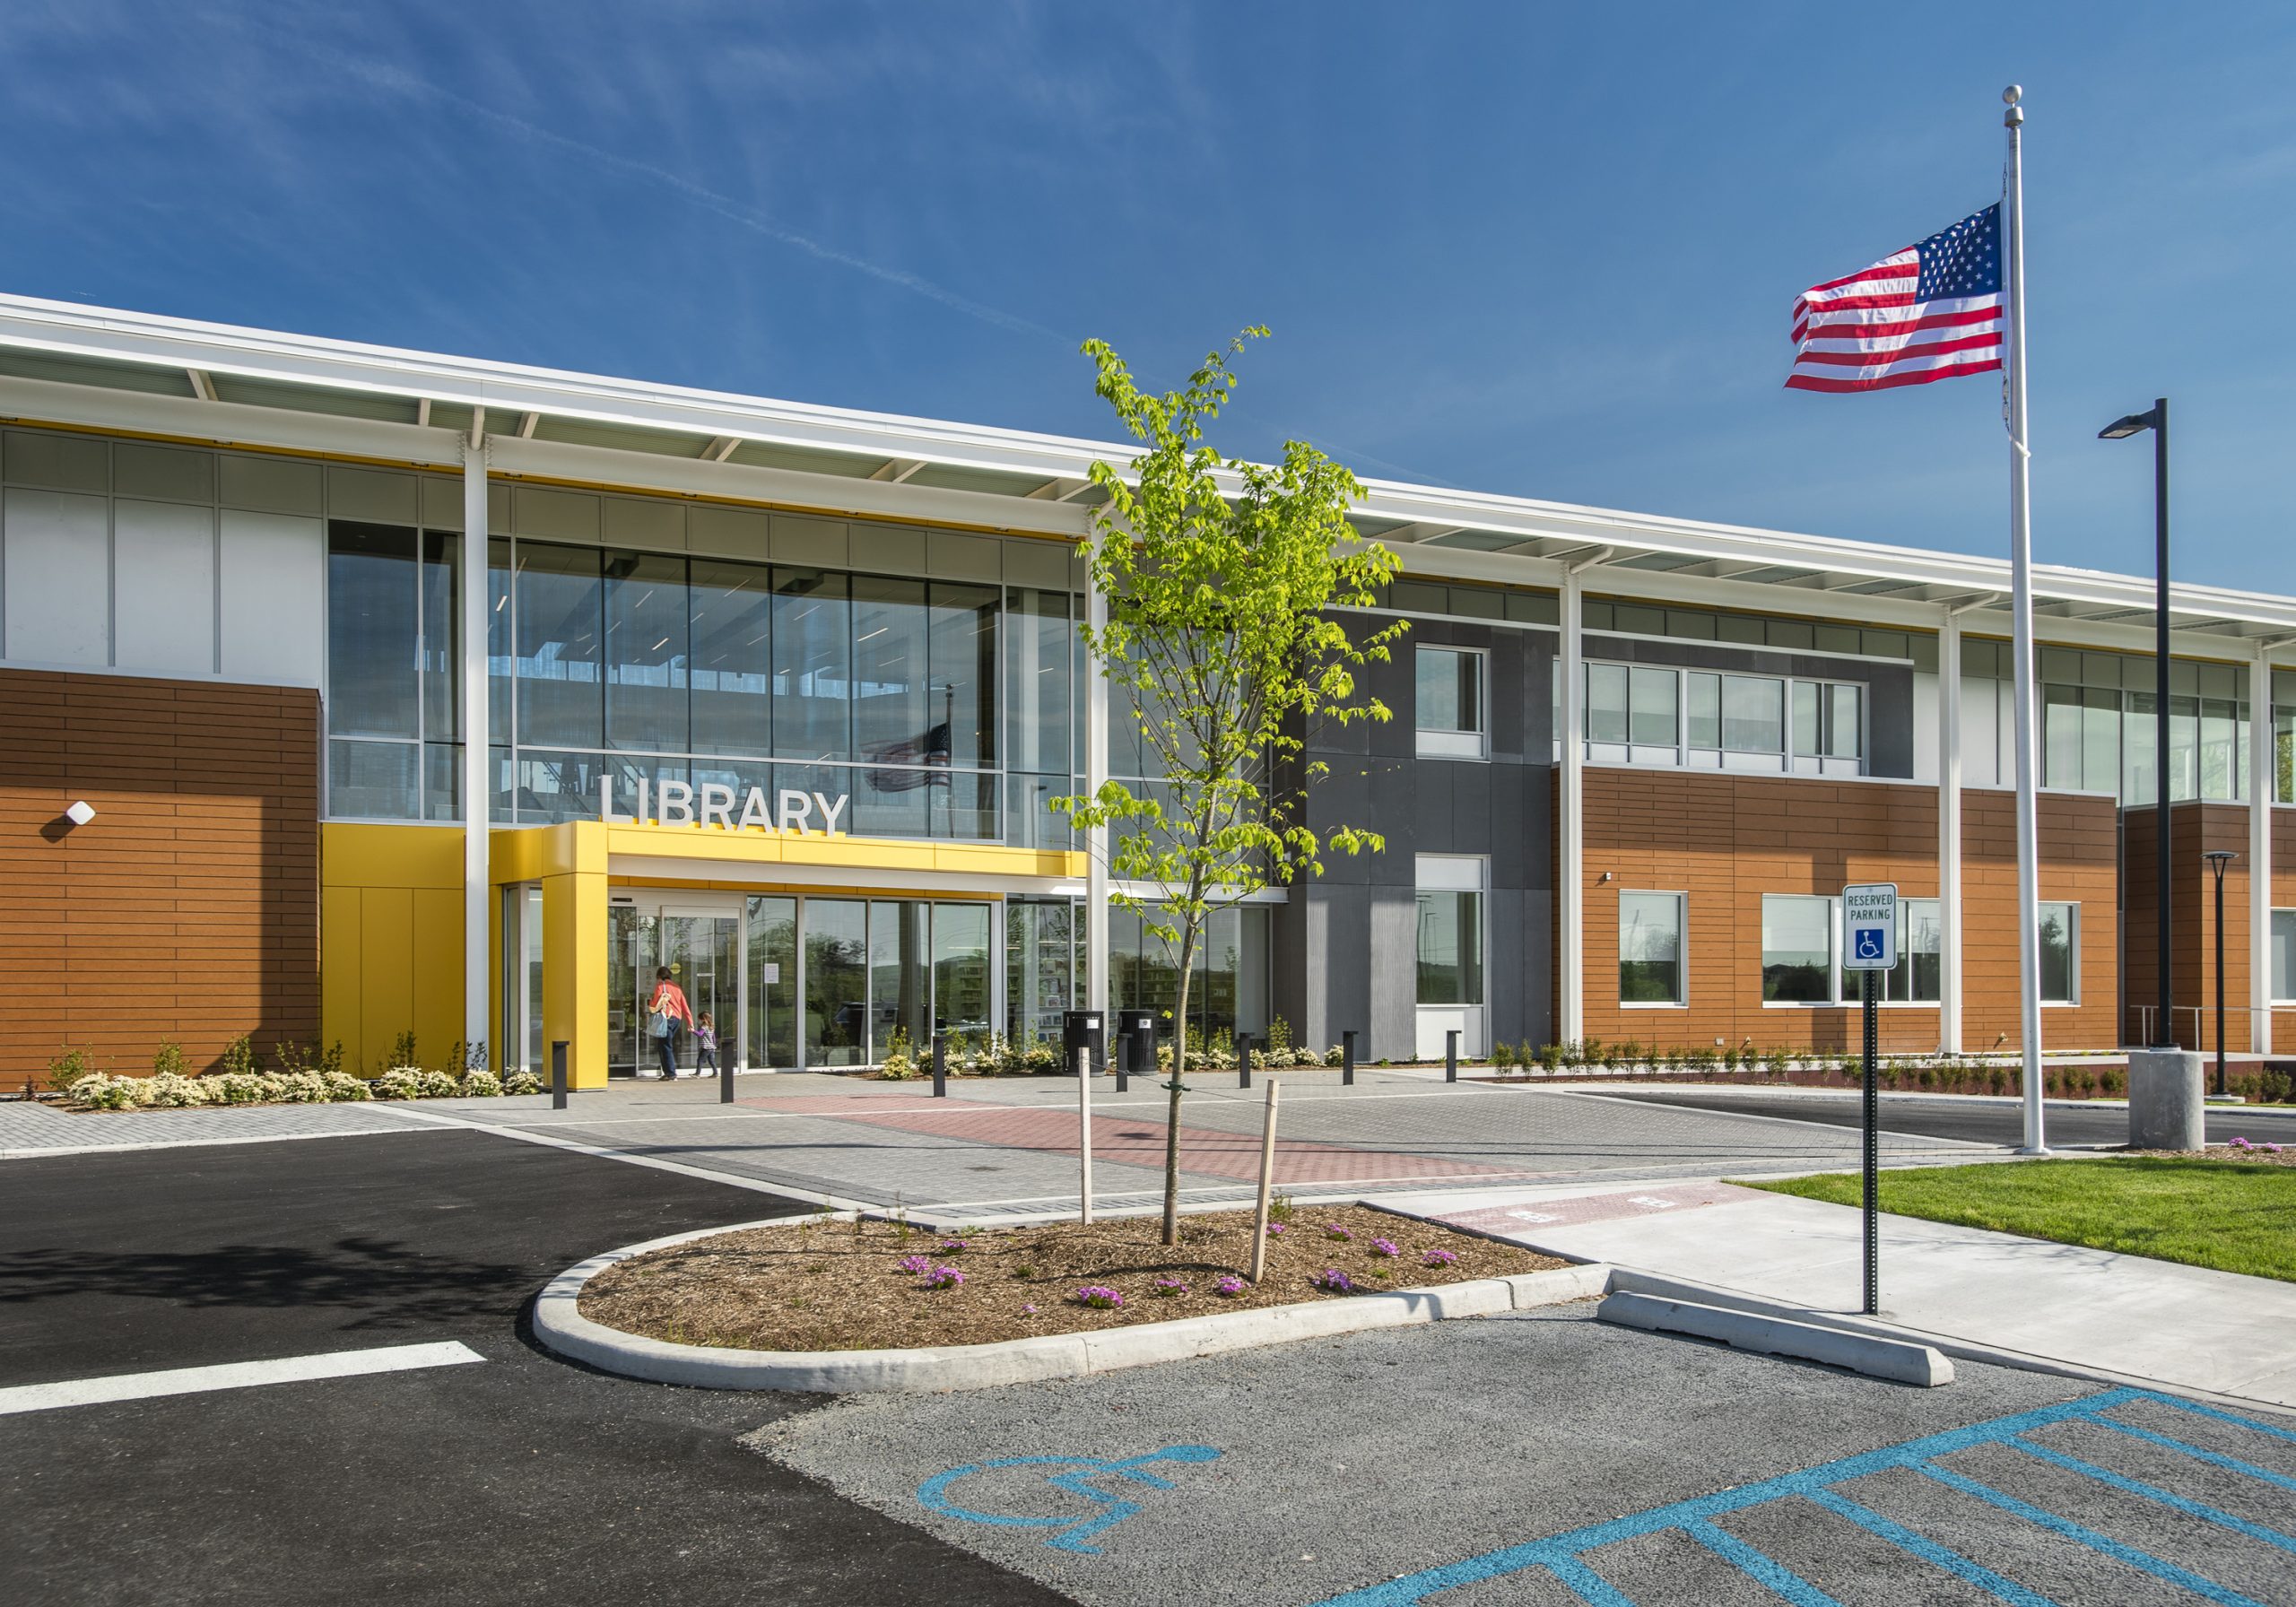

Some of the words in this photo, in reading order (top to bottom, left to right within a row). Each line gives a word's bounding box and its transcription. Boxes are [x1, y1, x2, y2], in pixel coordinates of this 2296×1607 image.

[601, 774, 848, 837] LIBRARY
[1848, 894, 1892, 906] RESERVED
[1851, 909, 1890, 920] PARKING
